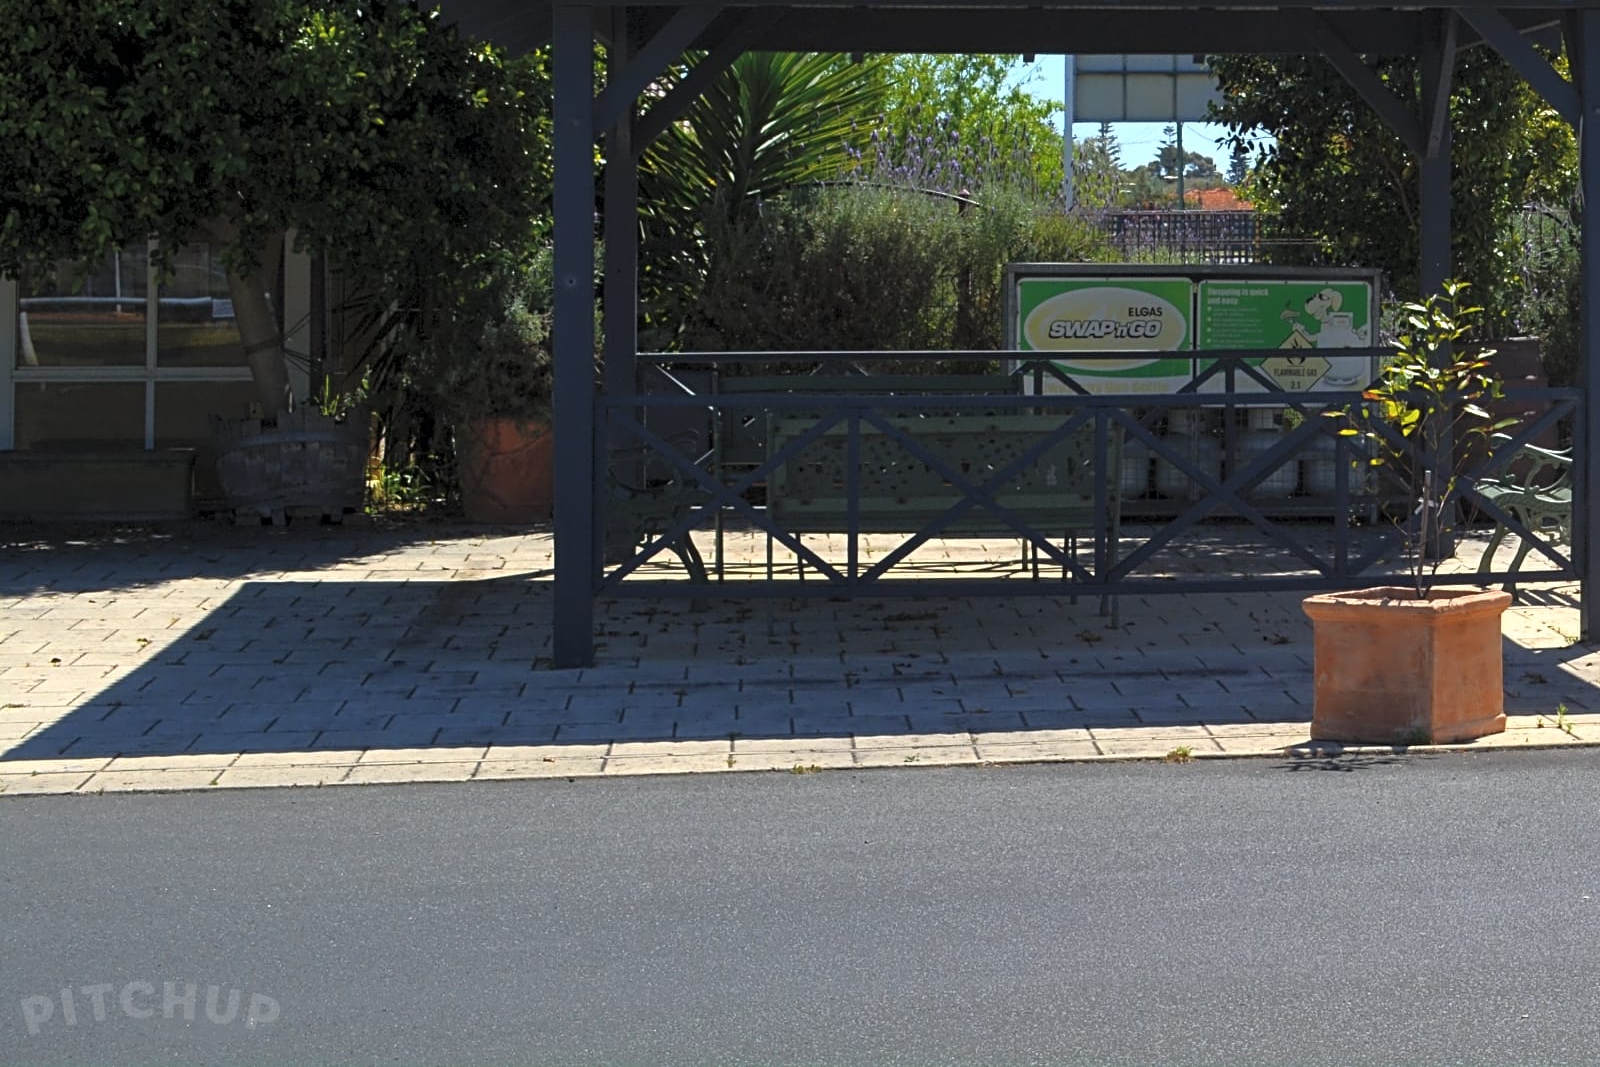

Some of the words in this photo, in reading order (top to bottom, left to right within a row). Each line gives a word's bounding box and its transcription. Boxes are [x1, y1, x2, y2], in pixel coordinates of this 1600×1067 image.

[1128, 307, 1163, 317] ELGAS
[1273, 367, 1305, 377] FLAMMABLE
[1306, 367, 1318, 377] GAS
[1290, 380, 1301, 390] 2.1
